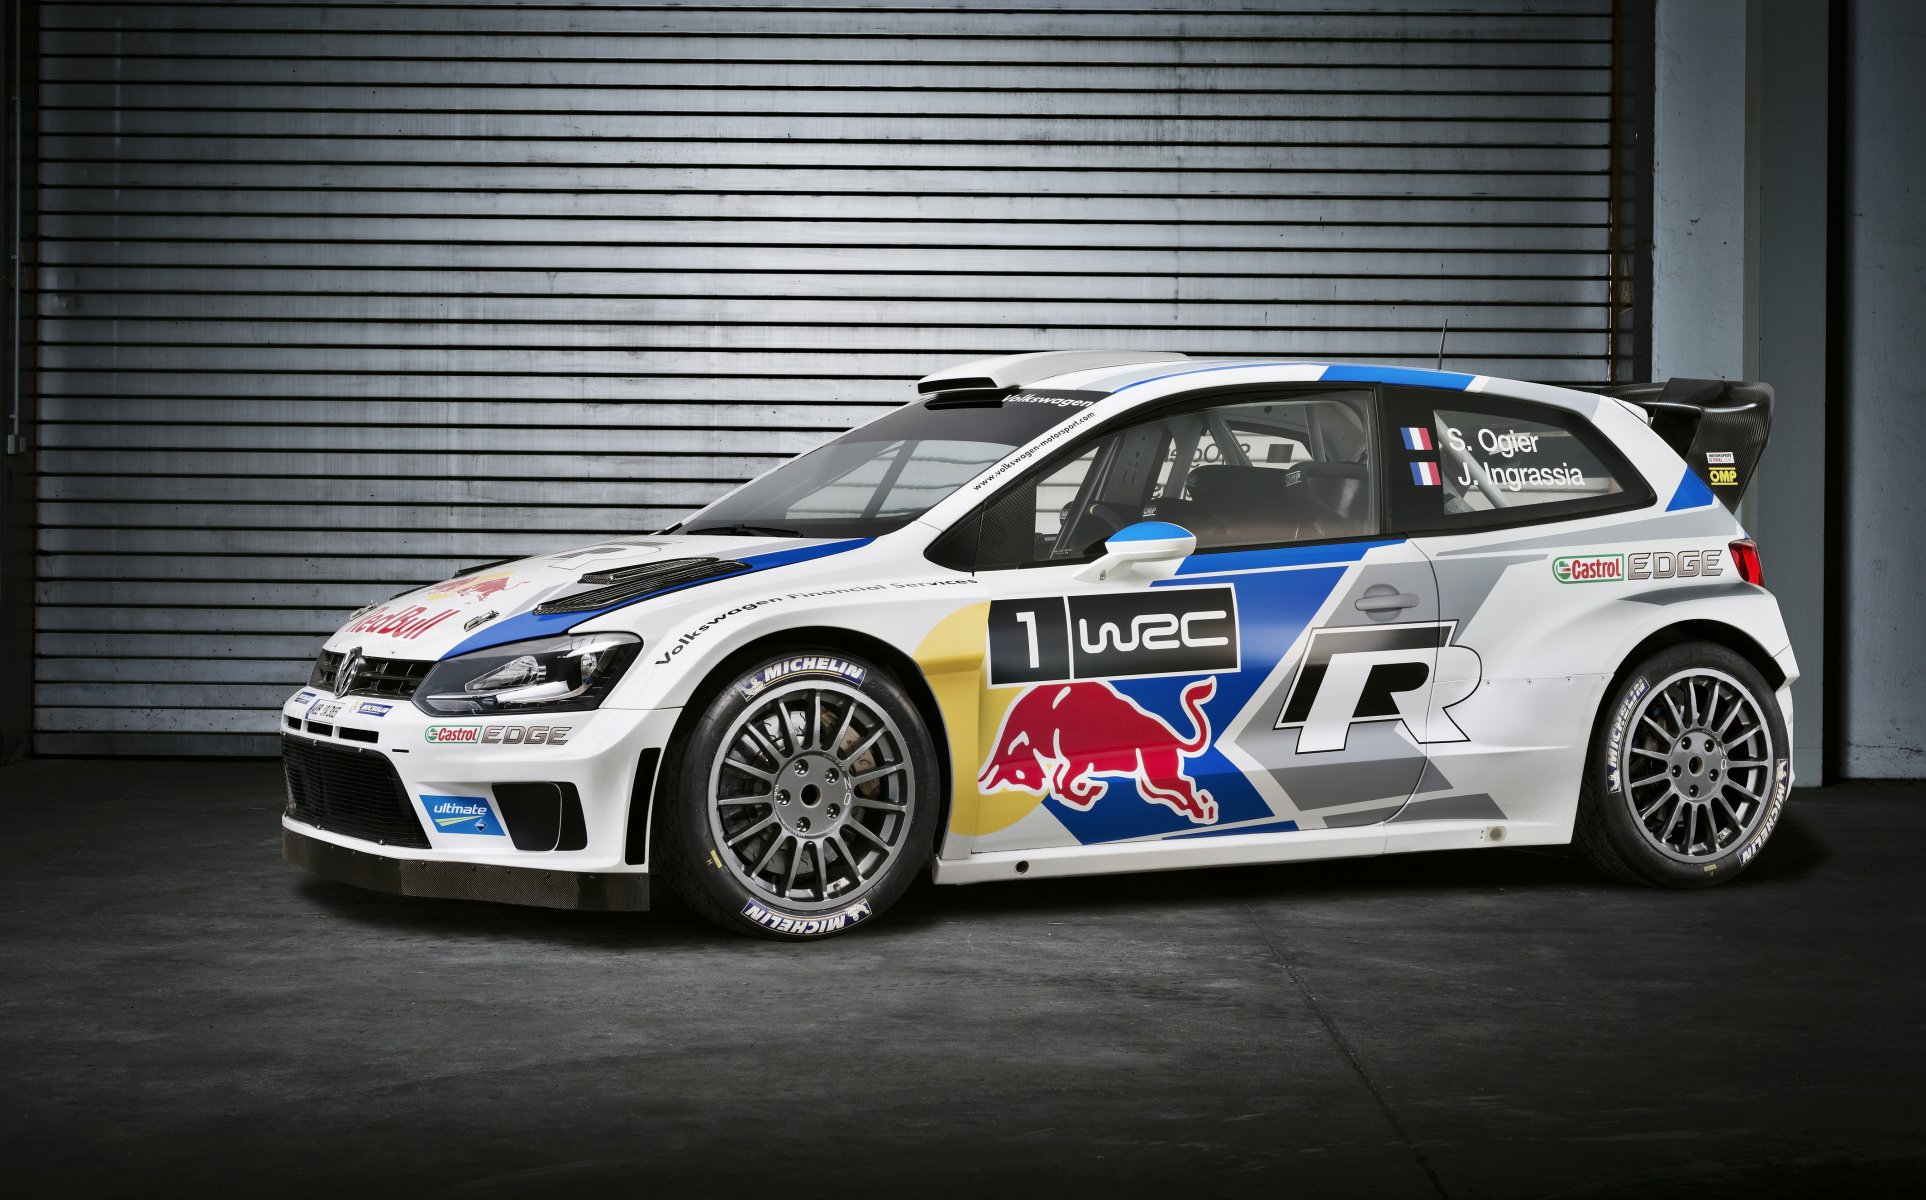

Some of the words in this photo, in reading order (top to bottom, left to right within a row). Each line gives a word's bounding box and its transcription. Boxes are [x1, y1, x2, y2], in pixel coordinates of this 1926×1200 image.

[1001, 393, 1095, 408] Volkswagen
[973, 411, 1096, 491] www.volkswagen-motorsport.com
[1447, 427, 1473, 451] S.
[1477, 429, 1539, 458] Ogier
[1457, 462, 1479, 486] J.
[1484, 461, 1586, 492] Ingrassia
[1709, 470, 1737, 483] OMP
[1571, 558, 1622, 580] Castrol
[1627, 549, 1724, 581] EDGE
[654, 596, 783, 666] Volkswagen
[787, 583, 886, 603] Financial
[893, 576, 979, 590] Services
[1078, 609, 1229, 654] WRC
[1015, 610, 1041, 669] 1
[764, 656, 864, 683] MICHELIN
[1290, 640, 1483, 755] R
[437, 727, 478, 742] Castrol
[480, 725, 573, 746] EDGE
[1607, 679, 1646, 768] MICHELIN
[433, 802, 488, 815] ultimate
[1741, 782, 1786, 864] MICHELIN
[744, 904, 846, 934] MICHELIN
